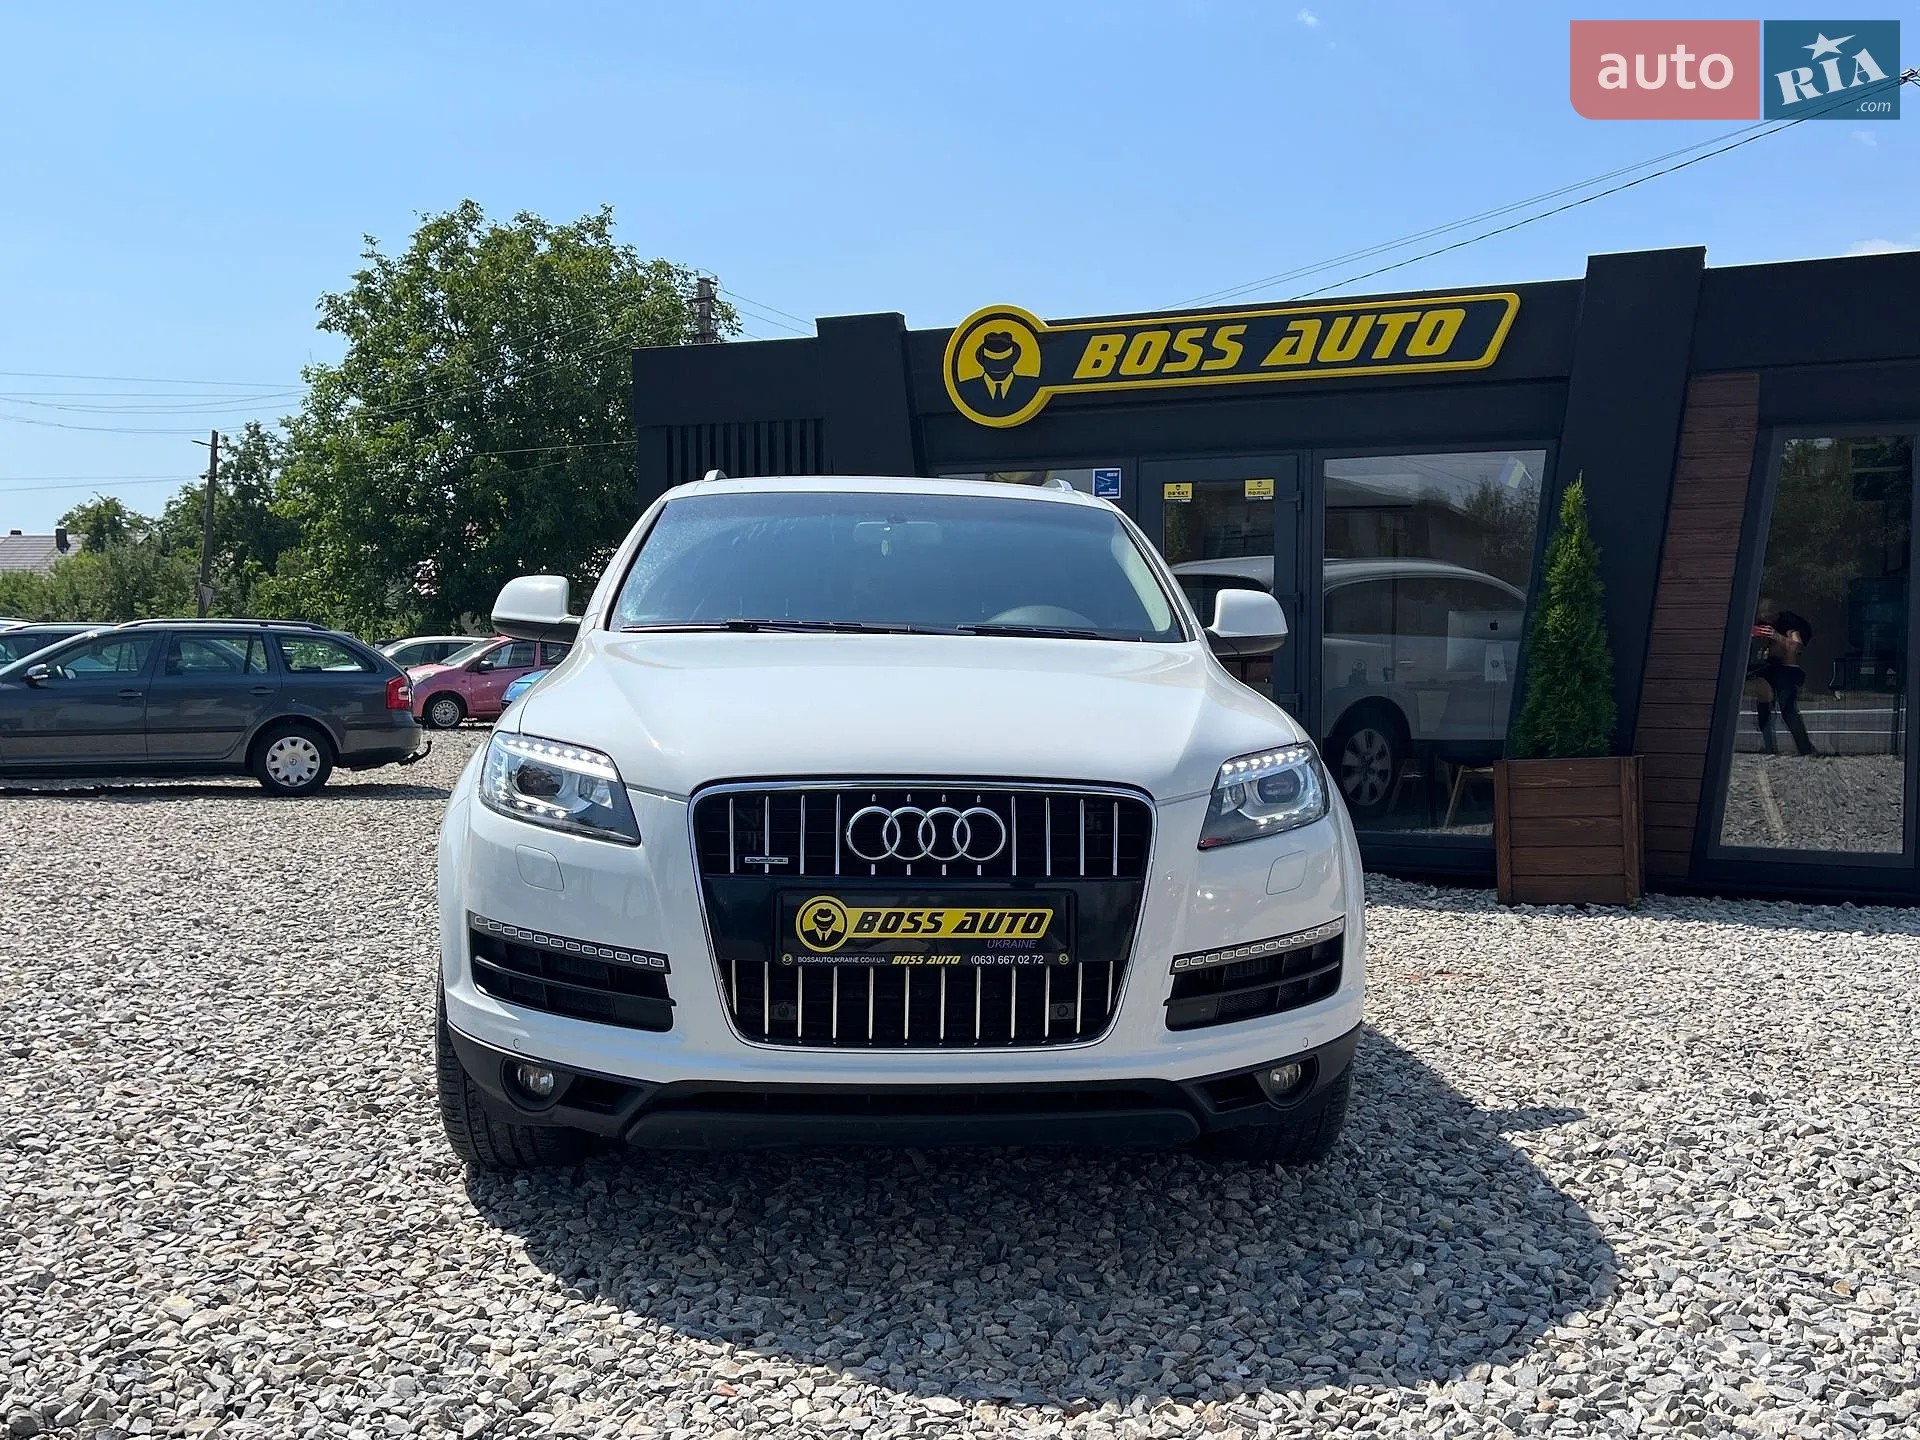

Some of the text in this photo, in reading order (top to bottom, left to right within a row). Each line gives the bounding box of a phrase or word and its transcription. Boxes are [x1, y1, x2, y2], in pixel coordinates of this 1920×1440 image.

[1072, 308, 1467, 379] BOSS AUTO
[853, 911, 1047, 935] BOSS AUTO
[986, 939, 1037, 949] UKRAINE
[797, 954, 1044, 965] BOSSAUTOUKRAINE.COM.UA BOSS AUTO (063) 667 02 72
